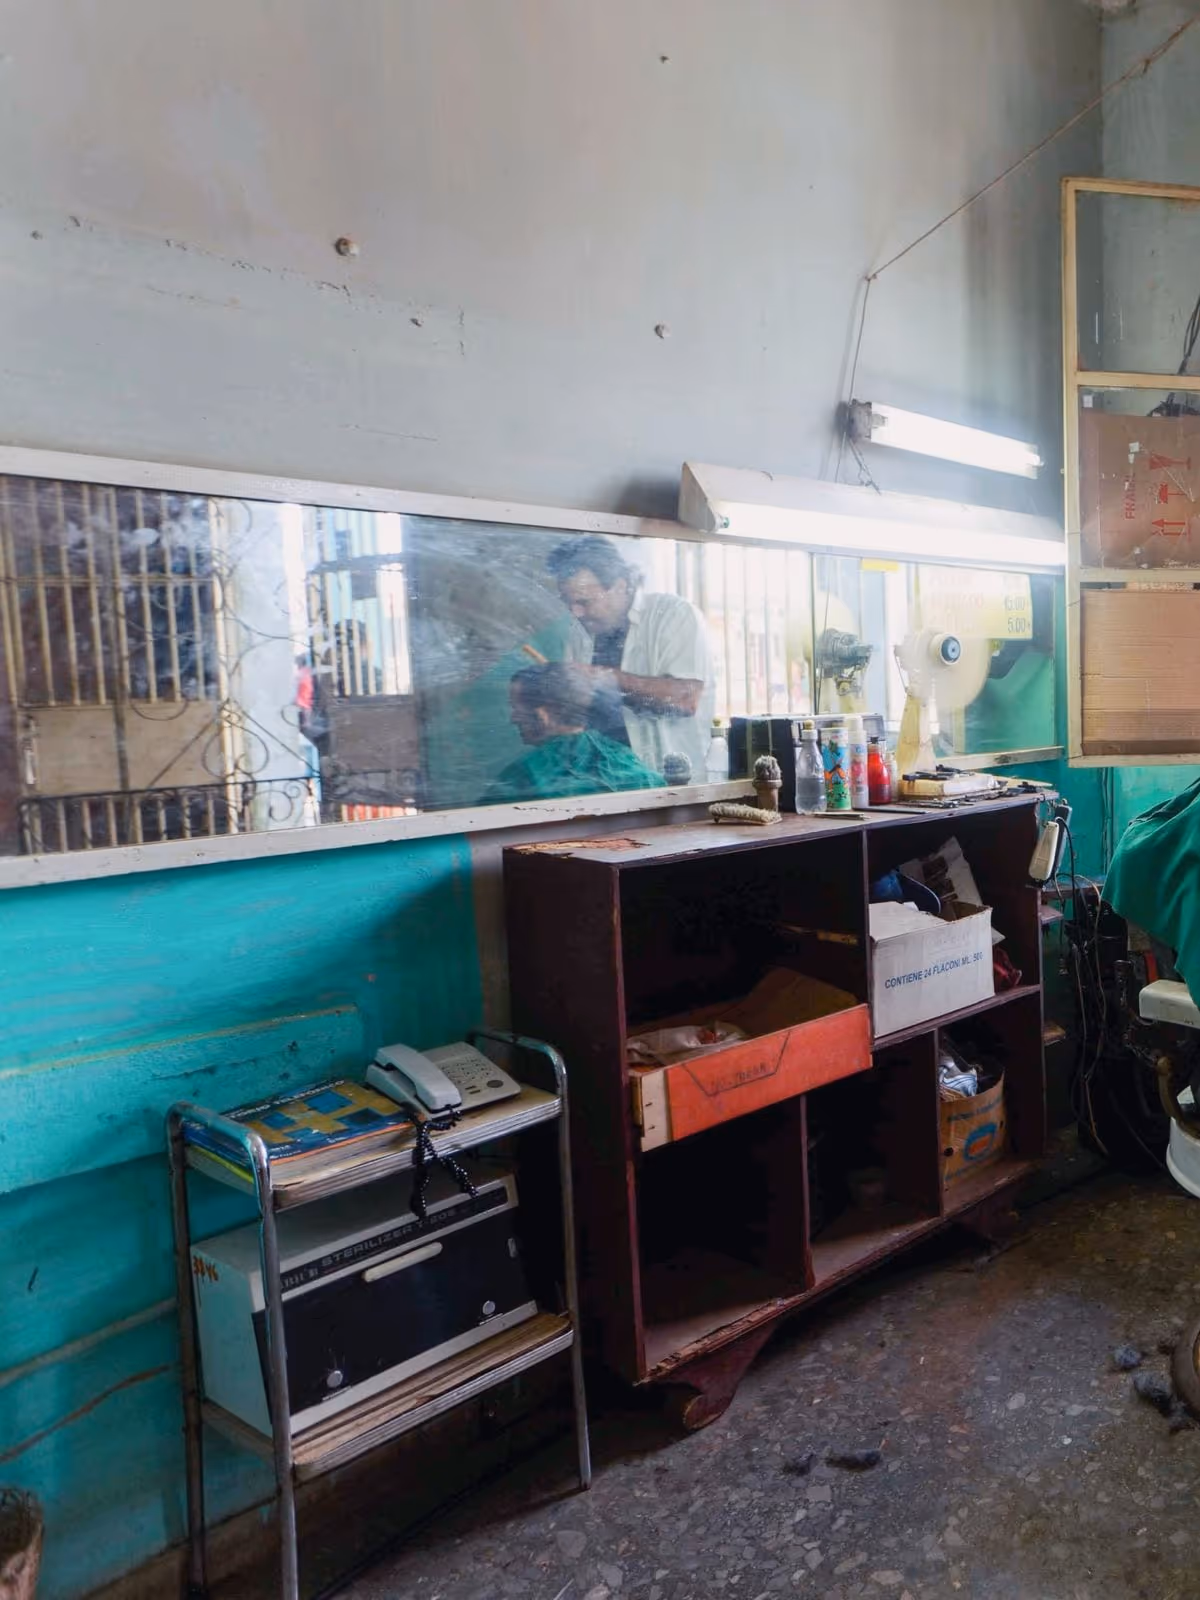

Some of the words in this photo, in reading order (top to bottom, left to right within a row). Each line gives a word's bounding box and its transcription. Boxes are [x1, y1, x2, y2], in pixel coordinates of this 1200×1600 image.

[884, 970, 923, 989] CONTIENE
[923, 968, 932, 979] 24
[320, 1224, 414, 1267] STERILIZER
